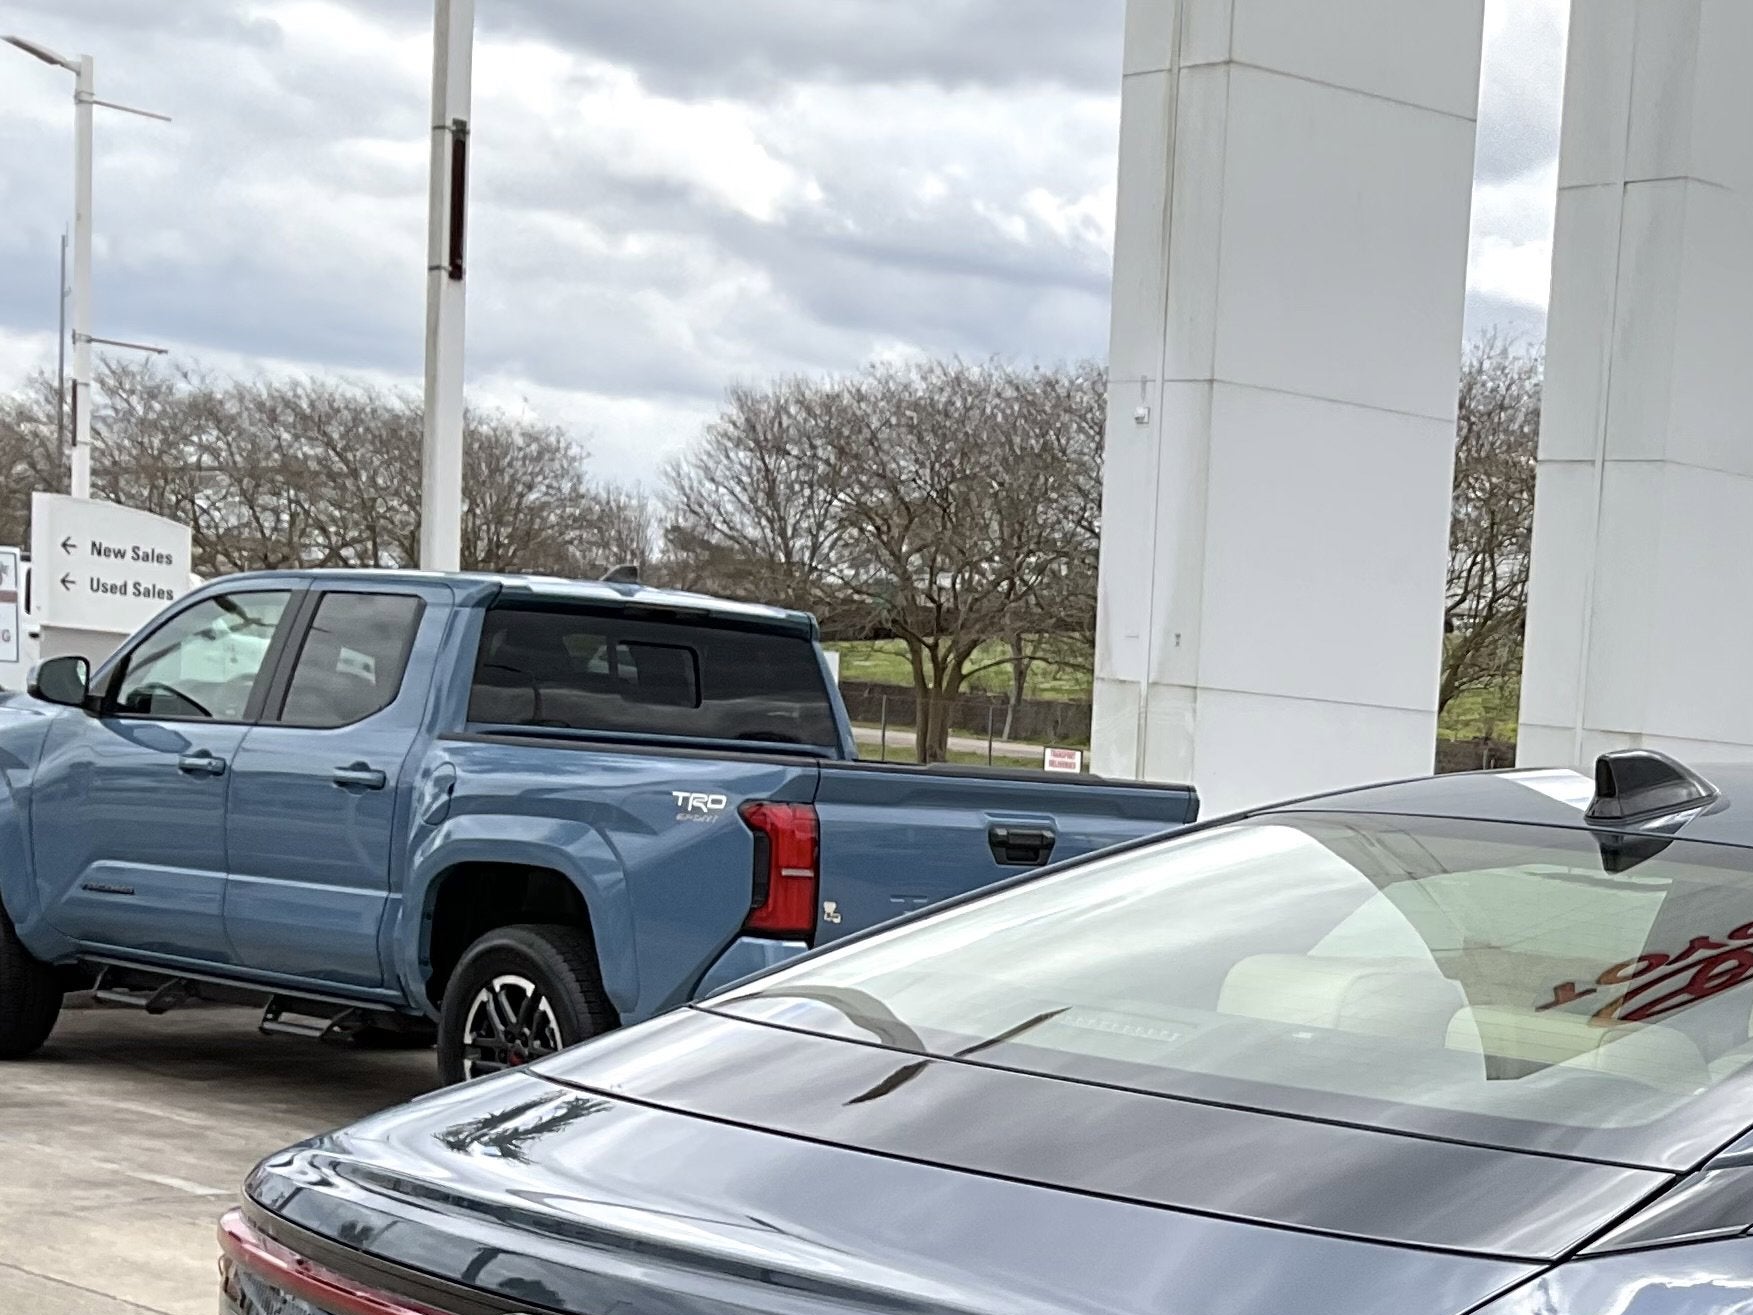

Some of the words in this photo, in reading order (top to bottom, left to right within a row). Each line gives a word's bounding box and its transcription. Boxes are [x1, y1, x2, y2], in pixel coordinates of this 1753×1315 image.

[91, 540, 126, 560] New
[131, 545, 173, 565] Sales
[90, 577, 127, 596] Used
[132, 581, 174, 600] Sales
[672, 791, 727, 812] TRD
